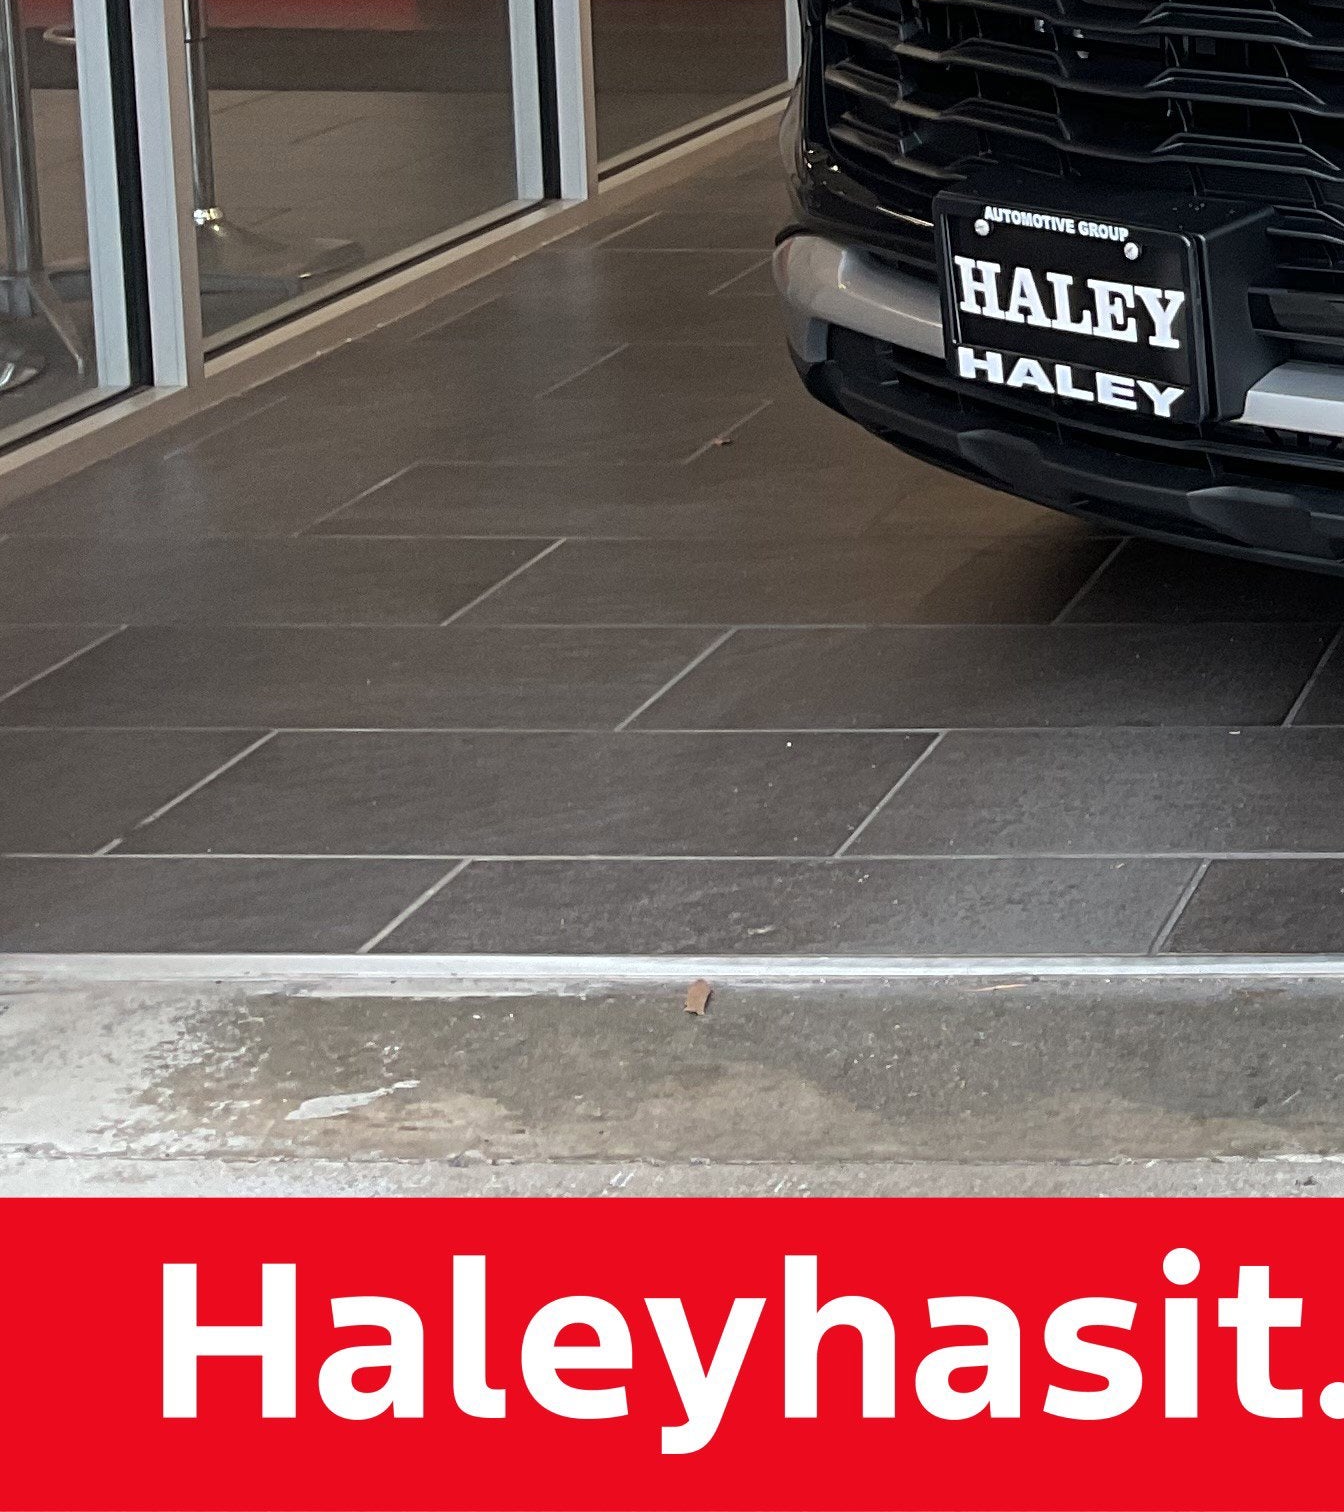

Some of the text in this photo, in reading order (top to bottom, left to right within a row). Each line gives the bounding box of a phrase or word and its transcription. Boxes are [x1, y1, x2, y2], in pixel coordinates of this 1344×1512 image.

[984, 205, 1130, 242] AUTOMOTIVE GROUP
[954, 255, 1186, 350] HALEY
[957, 346, 1186, 418] HALEY
